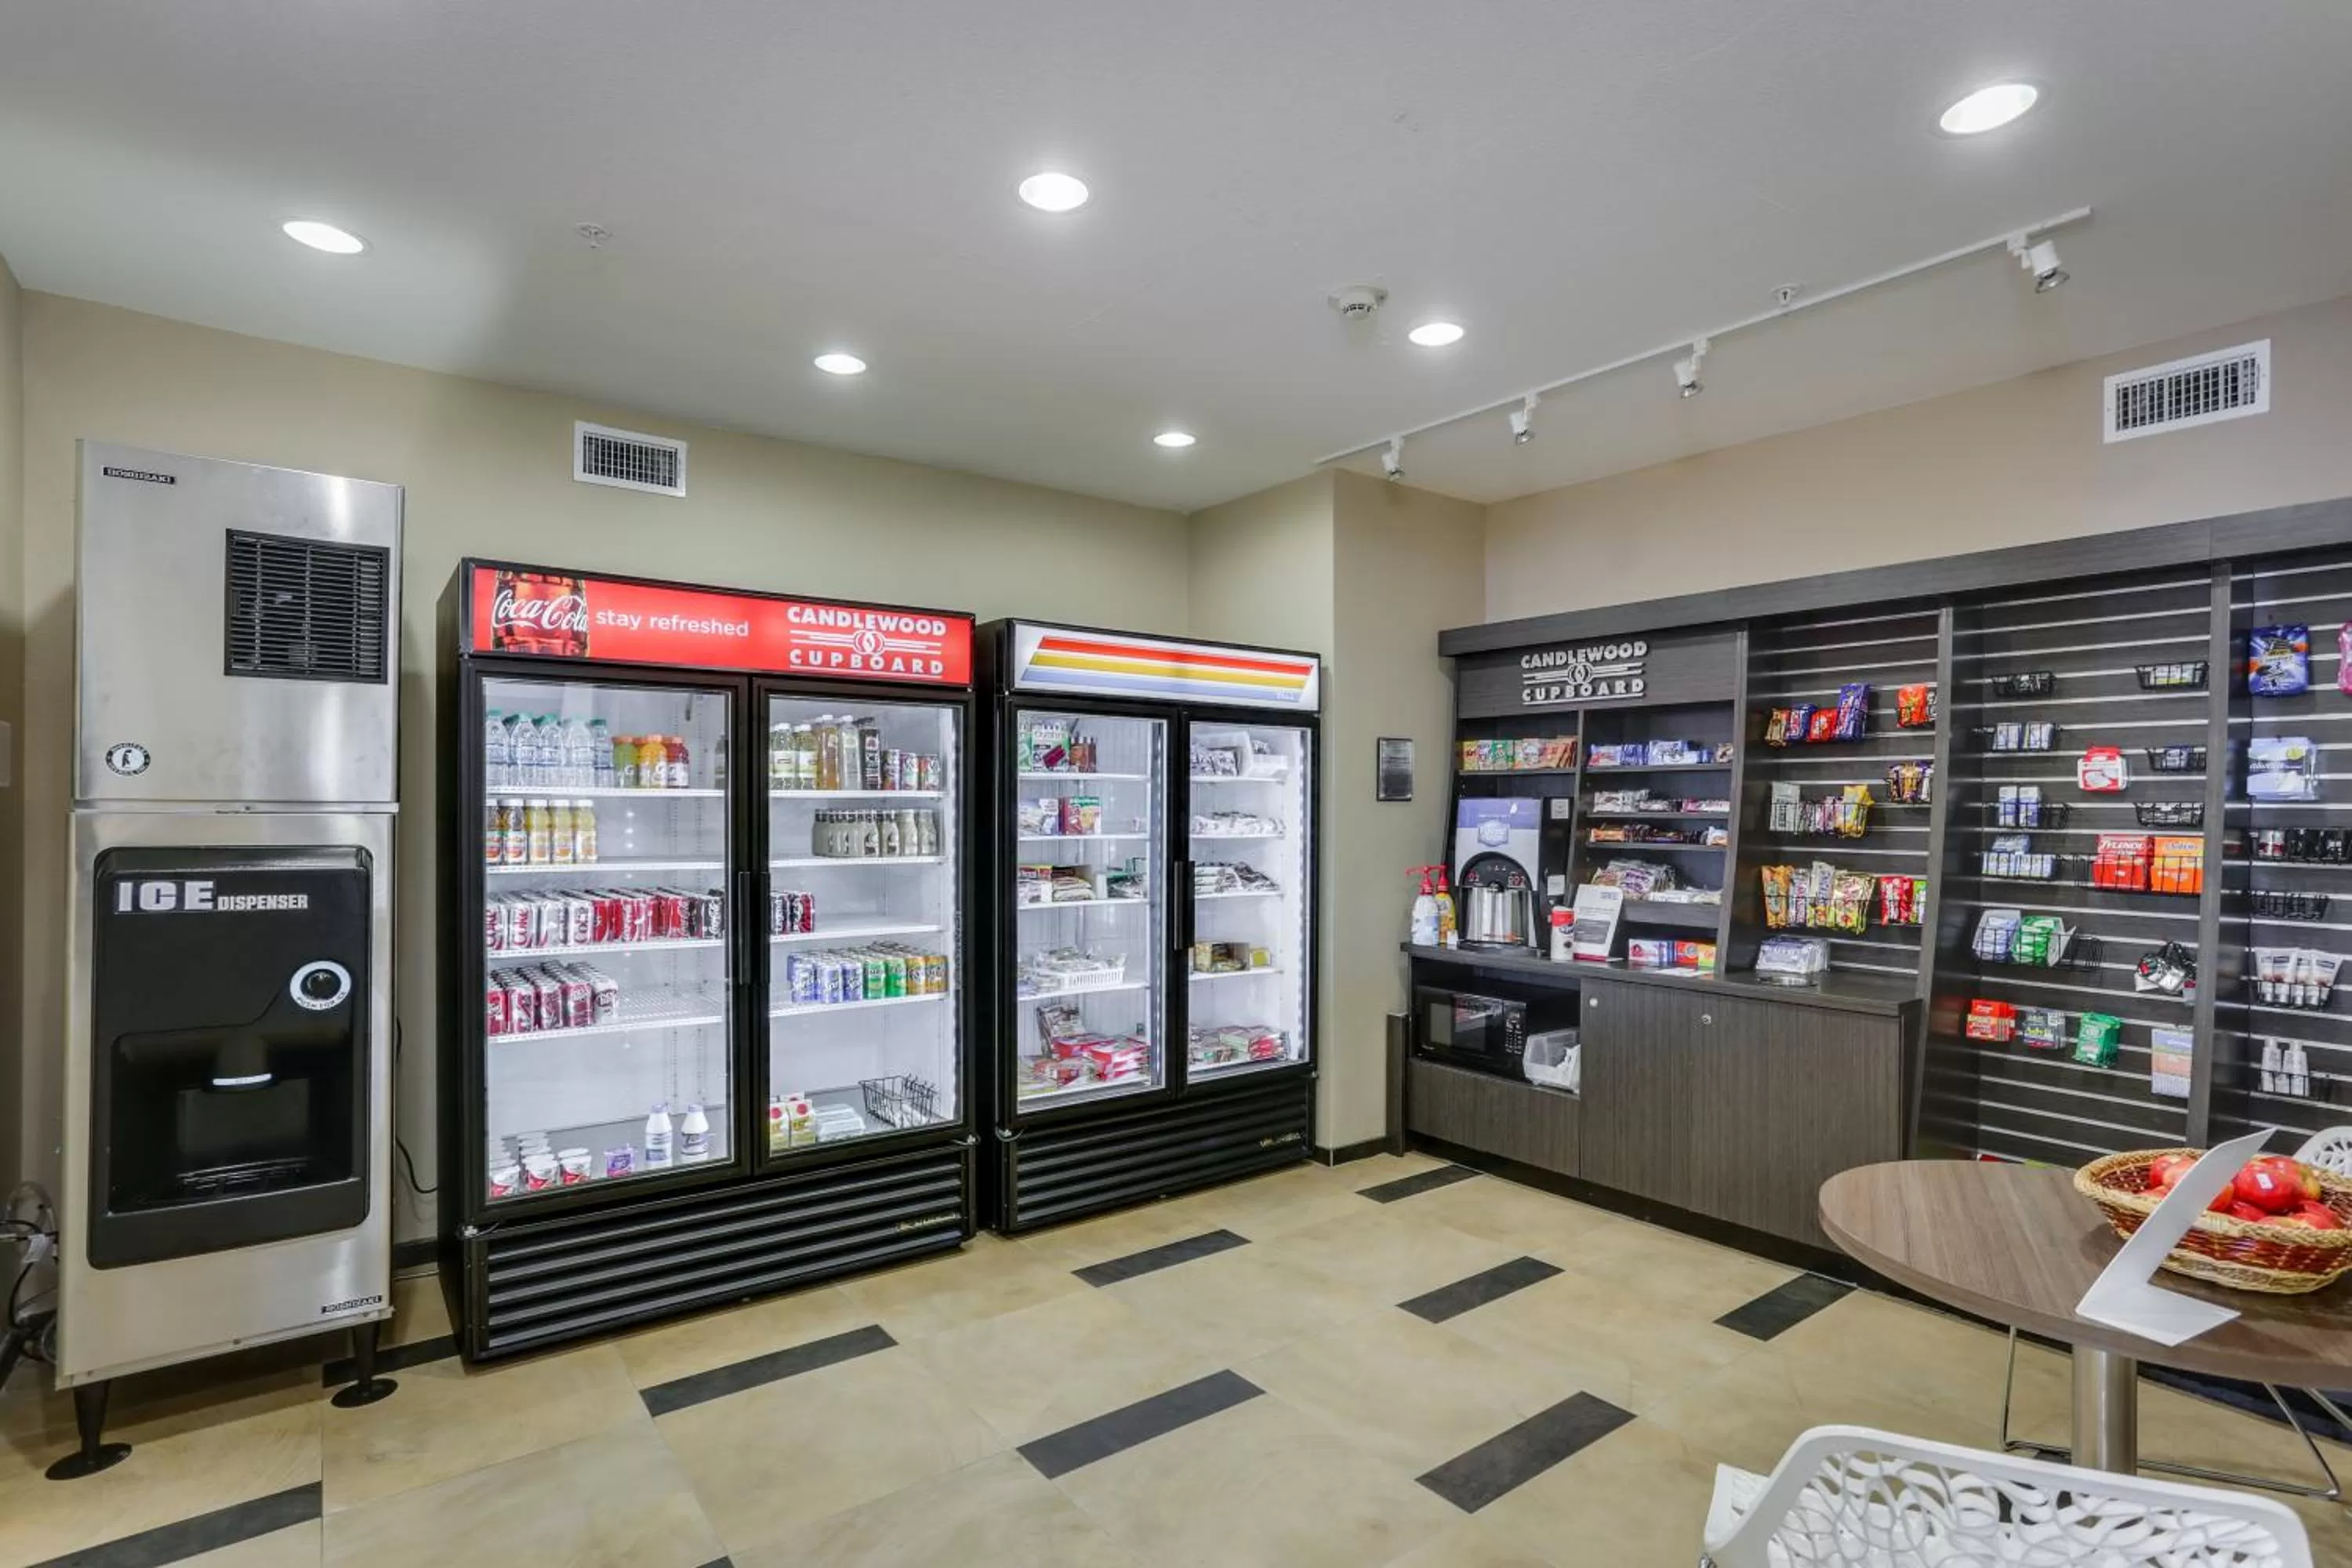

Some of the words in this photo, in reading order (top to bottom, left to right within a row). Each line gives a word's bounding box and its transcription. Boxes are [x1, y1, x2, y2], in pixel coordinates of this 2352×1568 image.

[595, 609, 642, 630] stay
[649, 613, 750, 637] refreshed
[786, 605, 947, 637] CANDLEWOOD
[789, 648, 945, 675] CUPBOARD
[1520, 640, 1647, 669] CANDLEWOOD
[1521, 677, 1645, 702] CUPBOARD
[118, 880, 214, 912] ICE
[217, 895, 308, 912] DISPENSER
